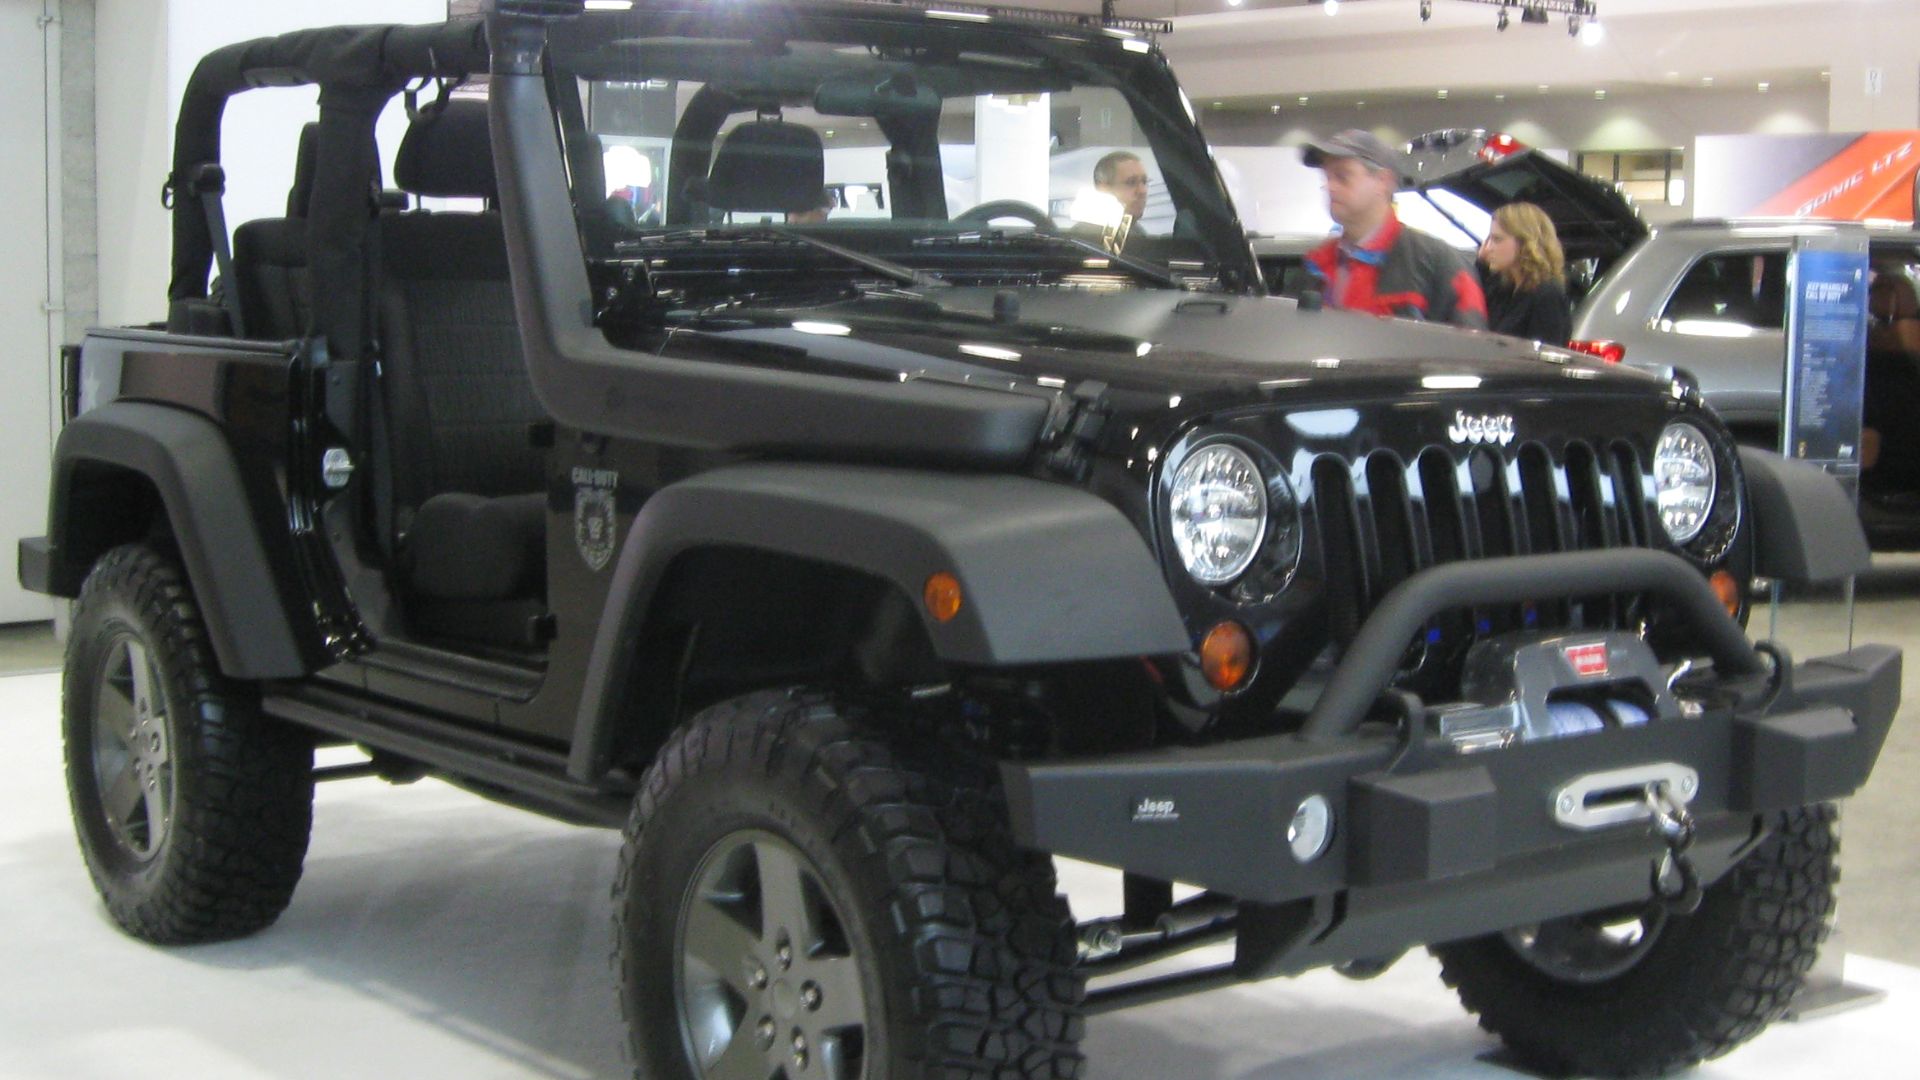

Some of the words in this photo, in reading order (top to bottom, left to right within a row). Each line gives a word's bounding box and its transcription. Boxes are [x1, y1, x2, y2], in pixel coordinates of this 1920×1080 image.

[1871, 141, 1914, 176] LTZ
[1448, 409, 1515, 448] Jeep
[1137, 798, 1174, 817] Jeep
